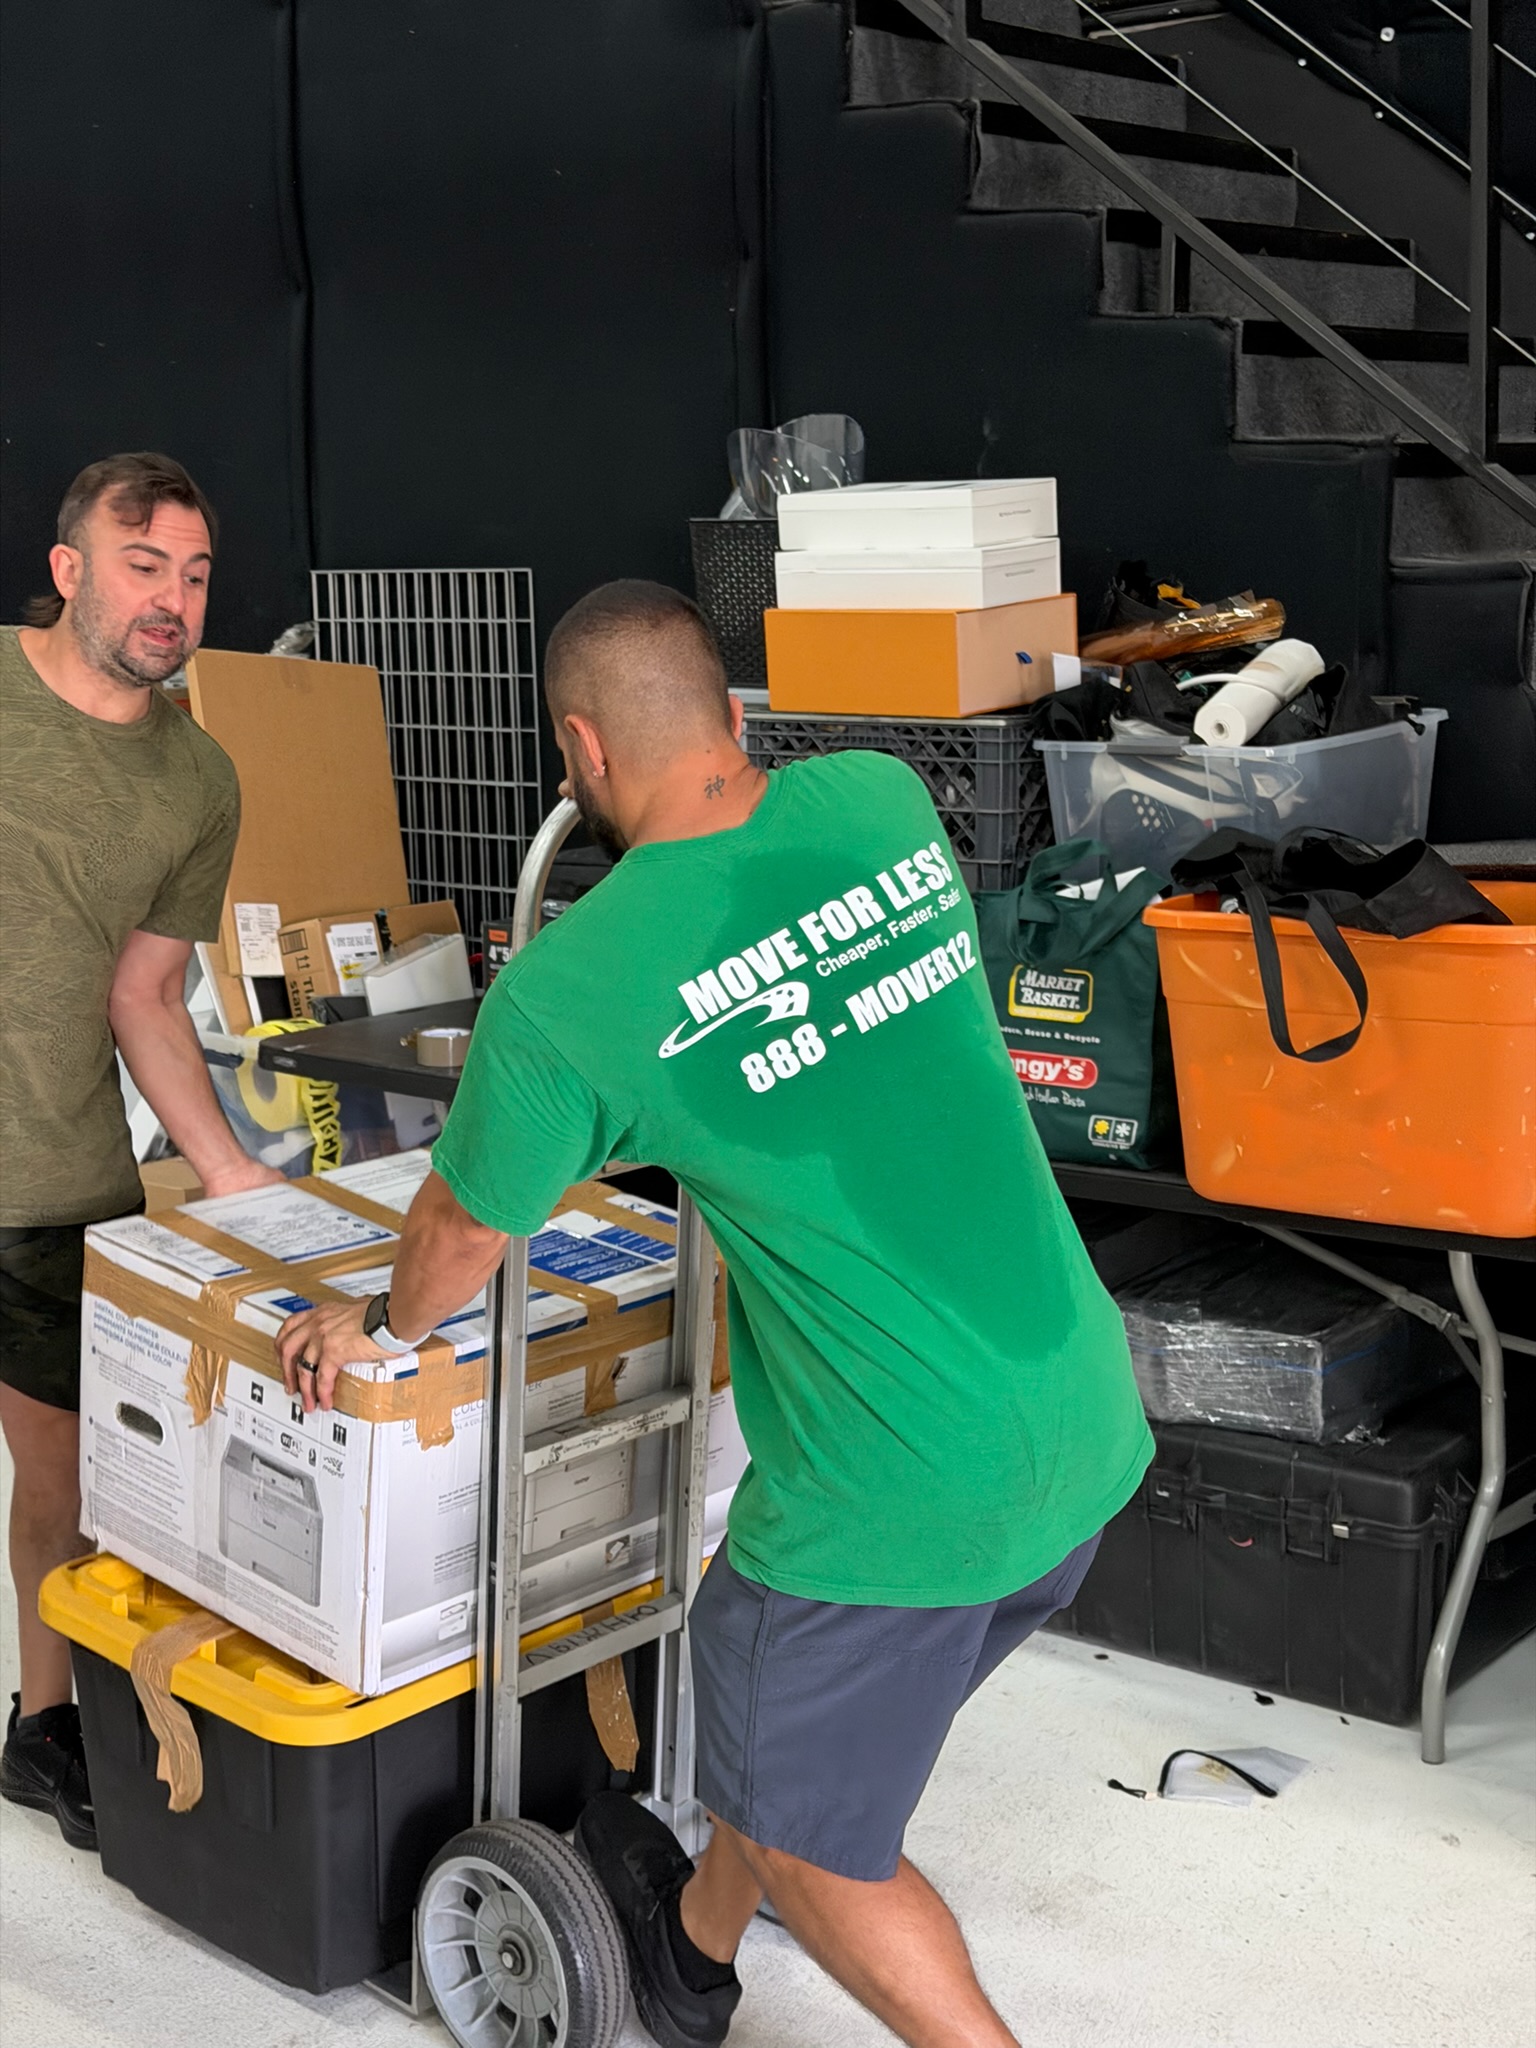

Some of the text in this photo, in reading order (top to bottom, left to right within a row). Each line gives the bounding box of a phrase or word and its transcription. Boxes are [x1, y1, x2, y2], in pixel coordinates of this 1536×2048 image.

[678, 841, 953, 1024] MOVE FOR LESS
[815, 932, 890, 978] Cheaper,
[886, 904, 939, 939] Faster,
[1019, 969, 1085, 992] MARKET
[740, 1023, 826, 1093] 888
[845, 931, 977, 1034] MOVER12
[1063, 1033, 1101, 1044] Recycle
[1011, 1057, 1085, 1082] ngy's
